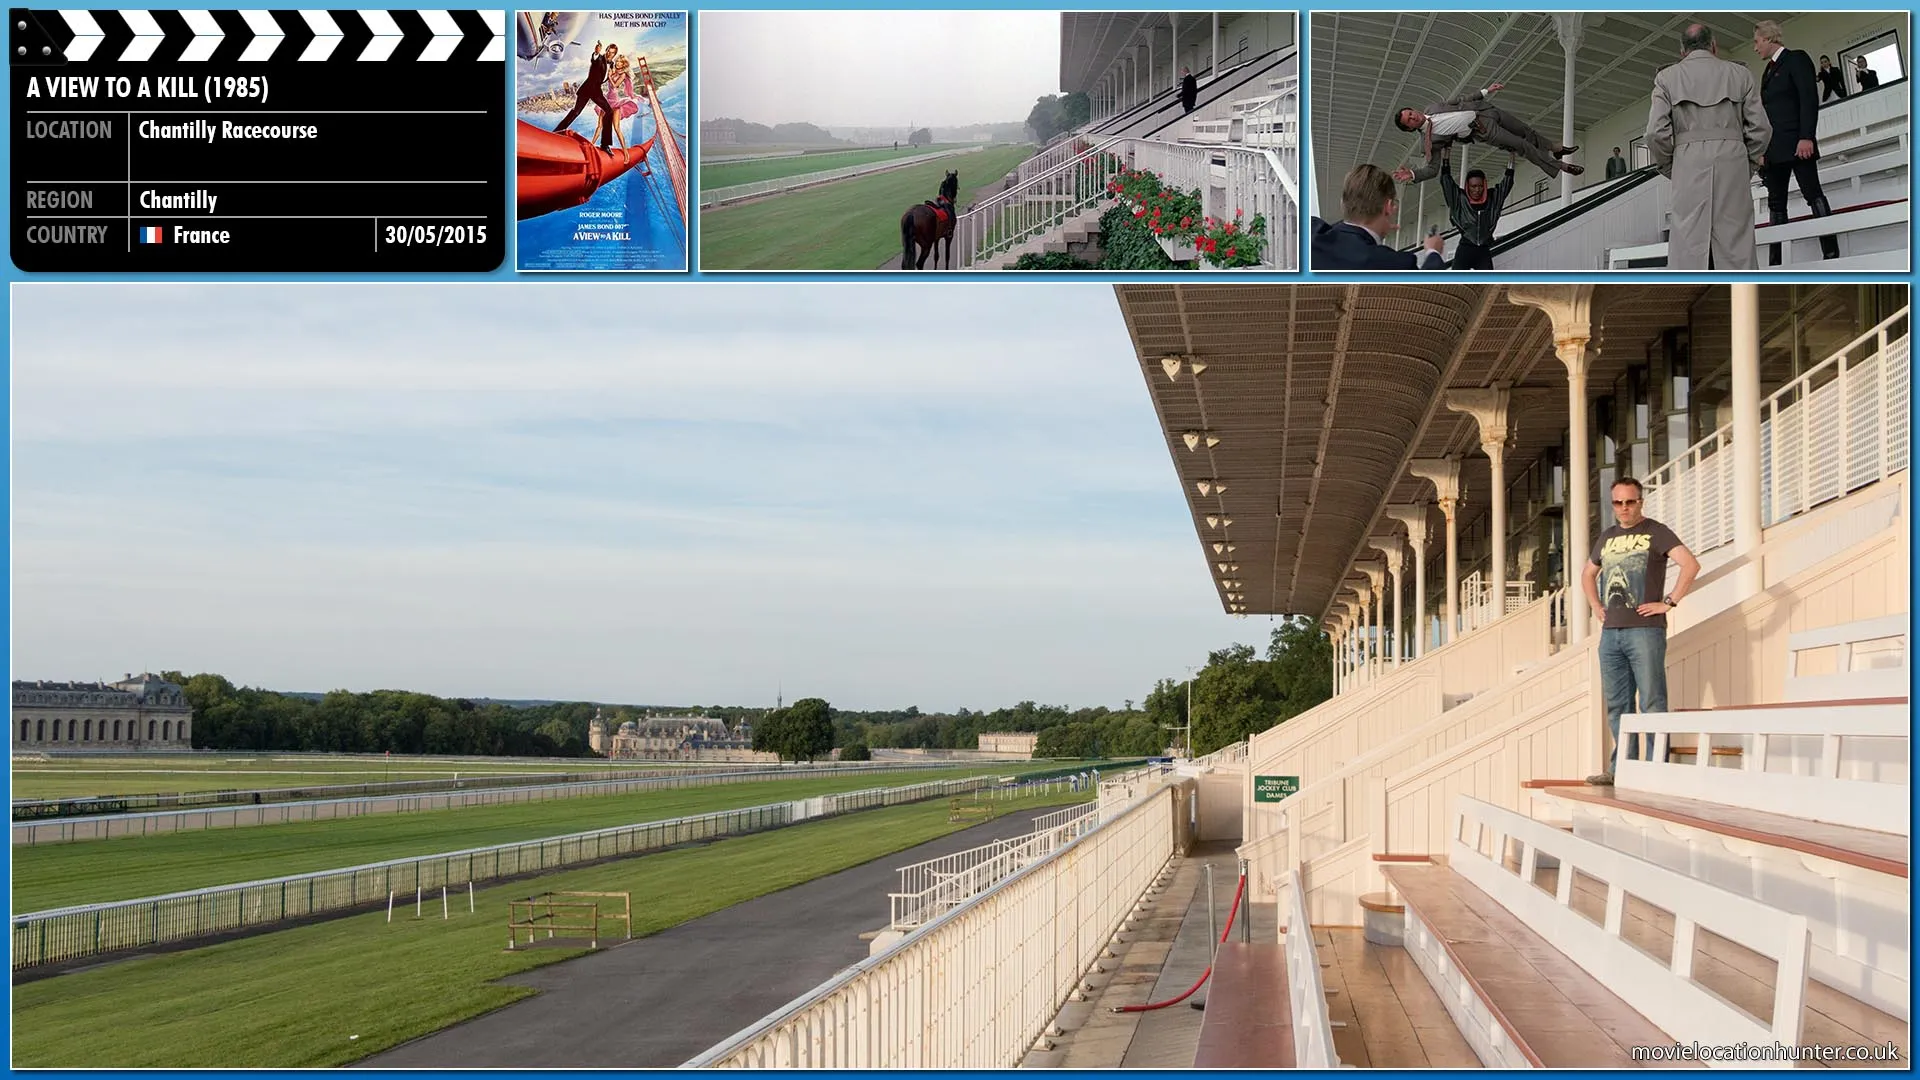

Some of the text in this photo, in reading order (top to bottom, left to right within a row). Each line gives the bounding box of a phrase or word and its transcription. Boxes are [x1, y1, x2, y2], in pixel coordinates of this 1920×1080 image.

[613, 12, 634, 20] JAMES
[578, 232, 600, 240] VIEW
[612, 232, 631, 240] KILL
[1600, 534, 1653, 557] JAWS
